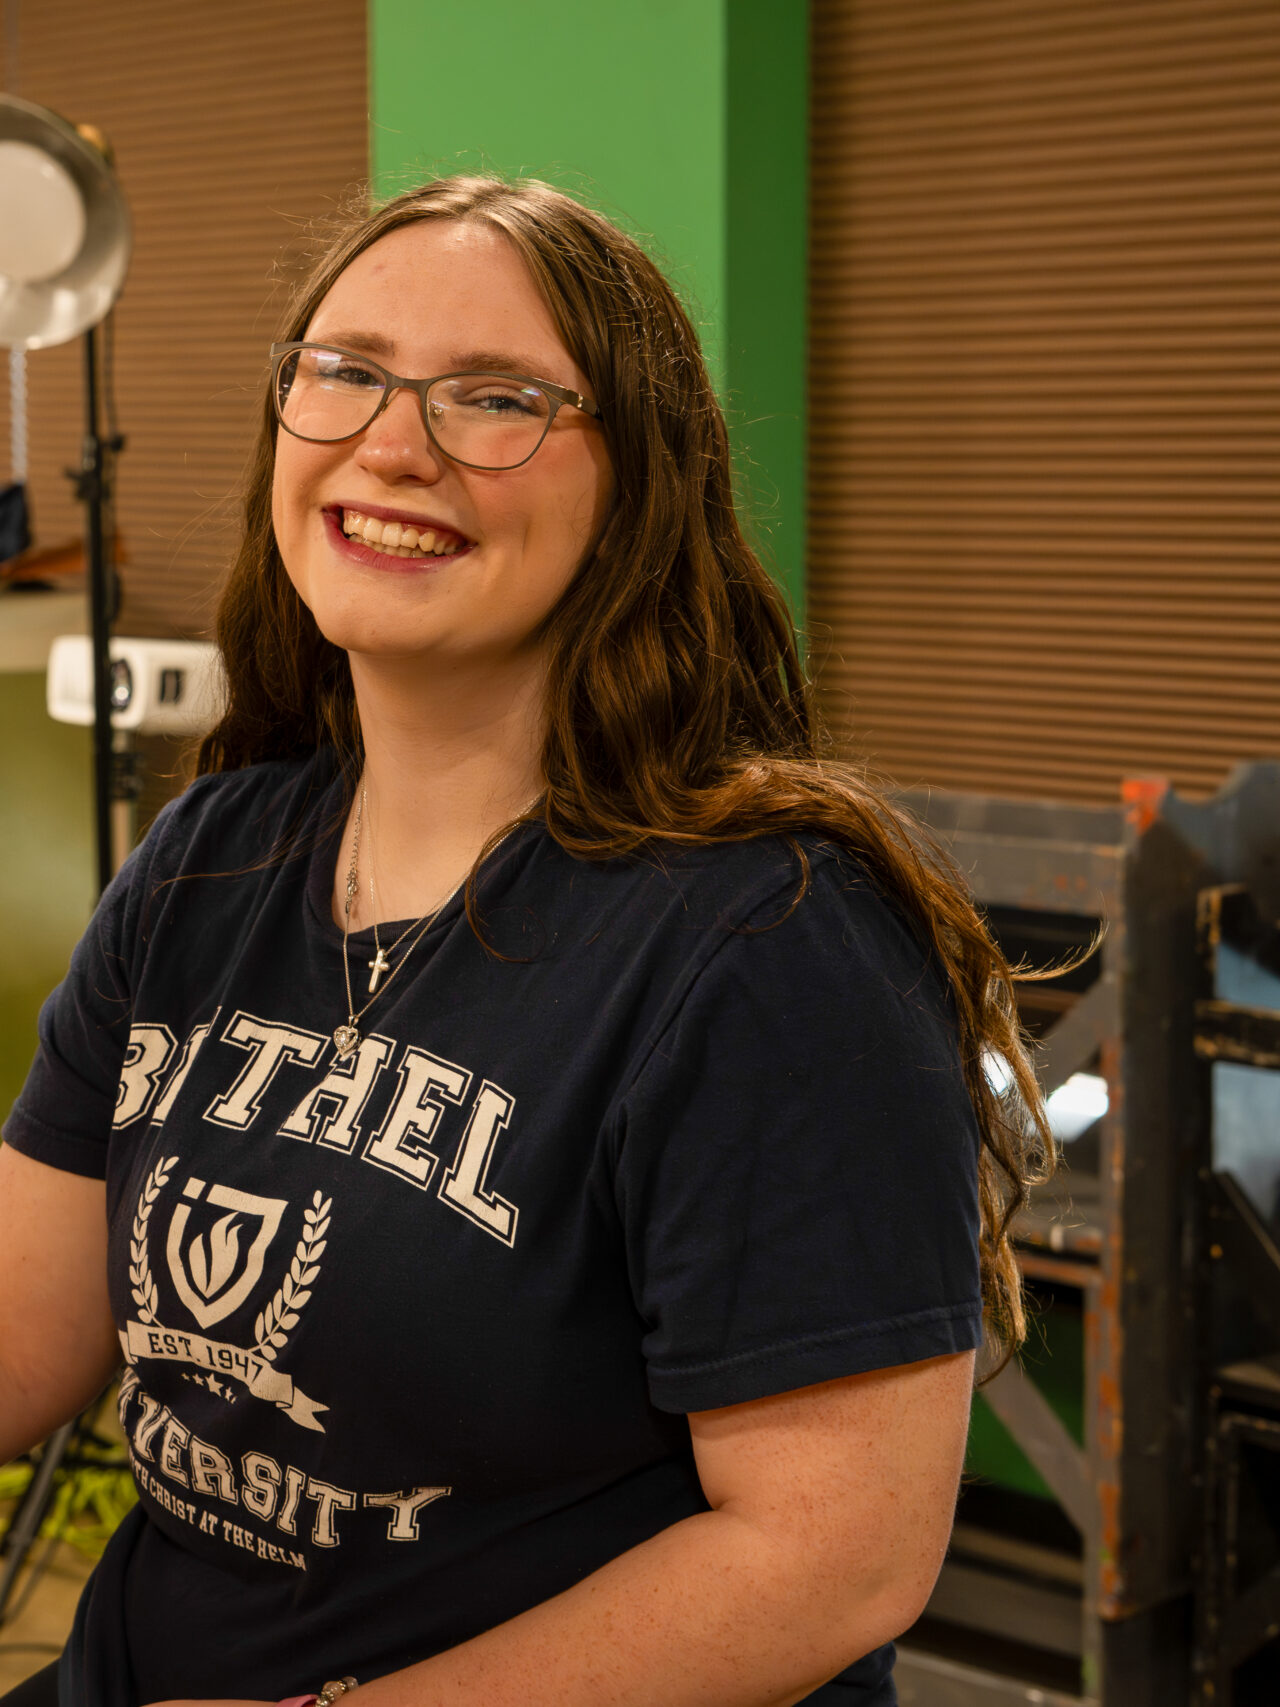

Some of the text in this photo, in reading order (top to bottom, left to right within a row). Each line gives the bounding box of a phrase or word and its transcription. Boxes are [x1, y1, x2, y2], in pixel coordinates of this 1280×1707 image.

[147, 1332, 263, 1383] EST. 1947
[149, 1476, 197, 1525] CHRIST
[199, 1510, 219, 1536] AT
[222, 1520, 255, 1553] THE
[257, 1537, 307, 1572] HELM
